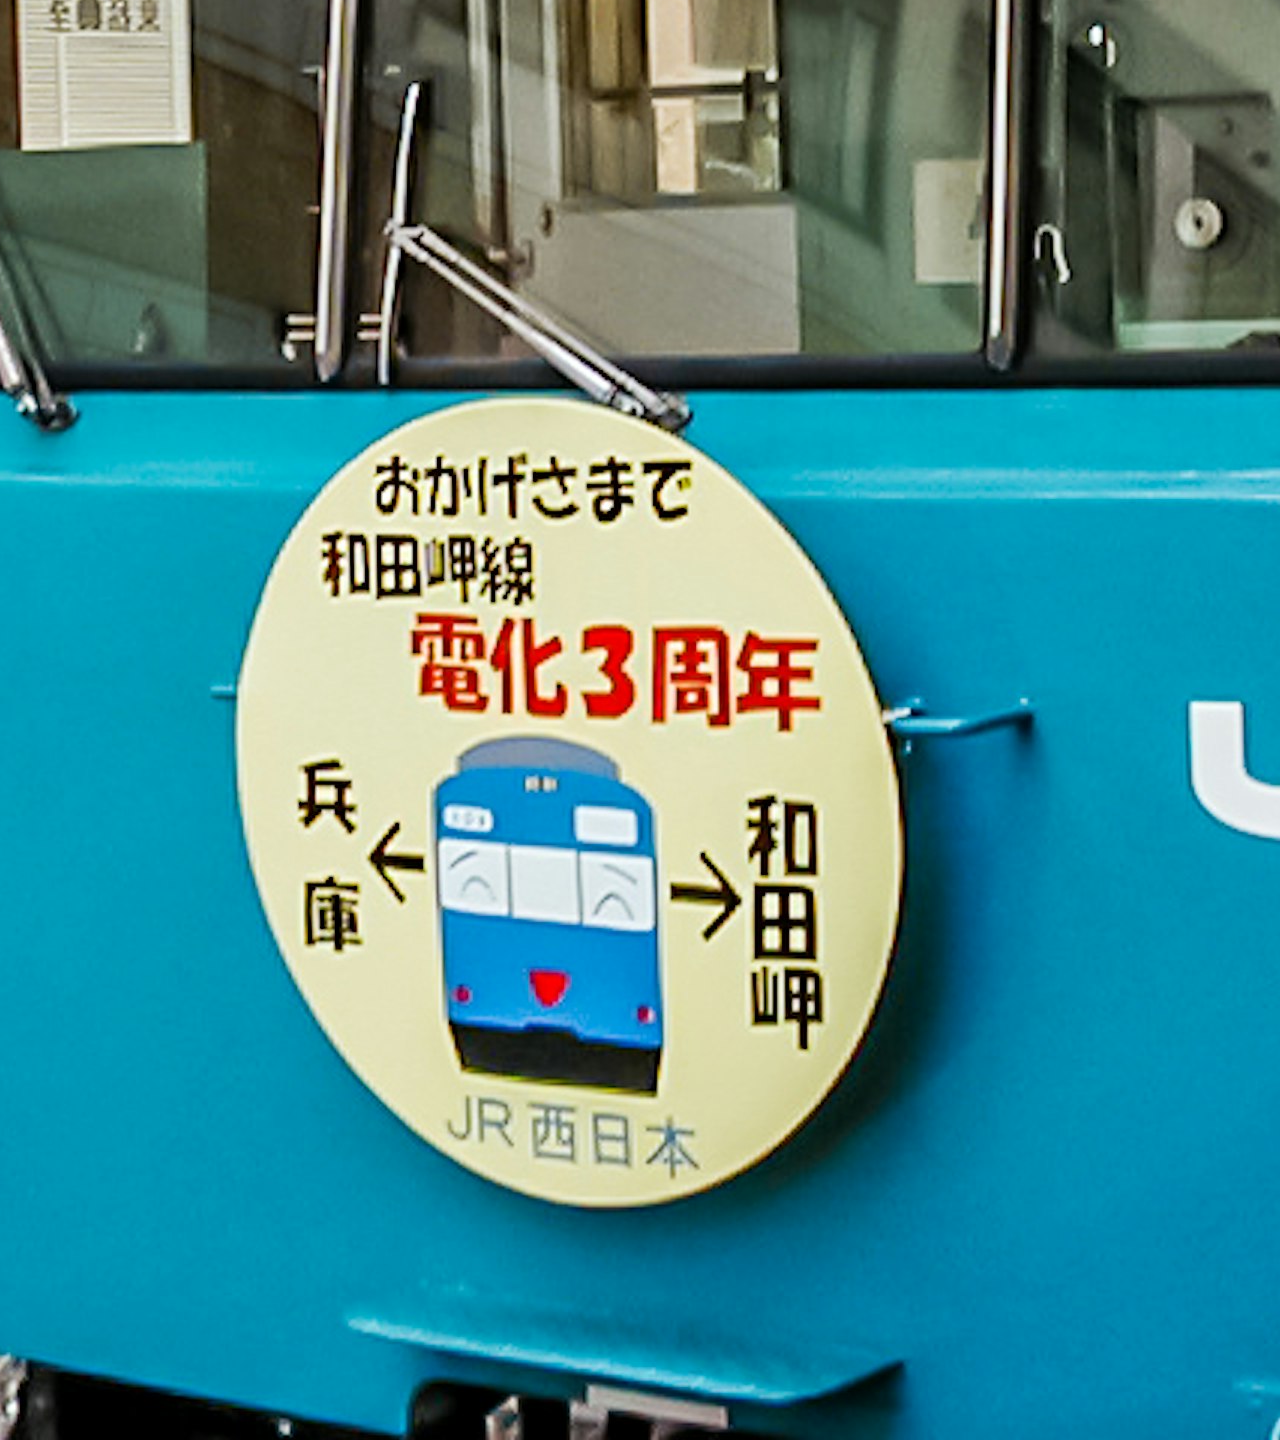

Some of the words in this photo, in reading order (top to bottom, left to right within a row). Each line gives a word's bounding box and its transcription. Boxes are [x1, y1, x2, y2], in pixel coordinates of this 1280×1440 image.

[374, 456, 693, 522] おかげさまで
[321, 532, 536, 605] 和田岬線
[411, 613, 822, 731] 電化3周年
[298, 760, 362, 951] 兵庫
[746, 795, 825, 1049] 和田岬
